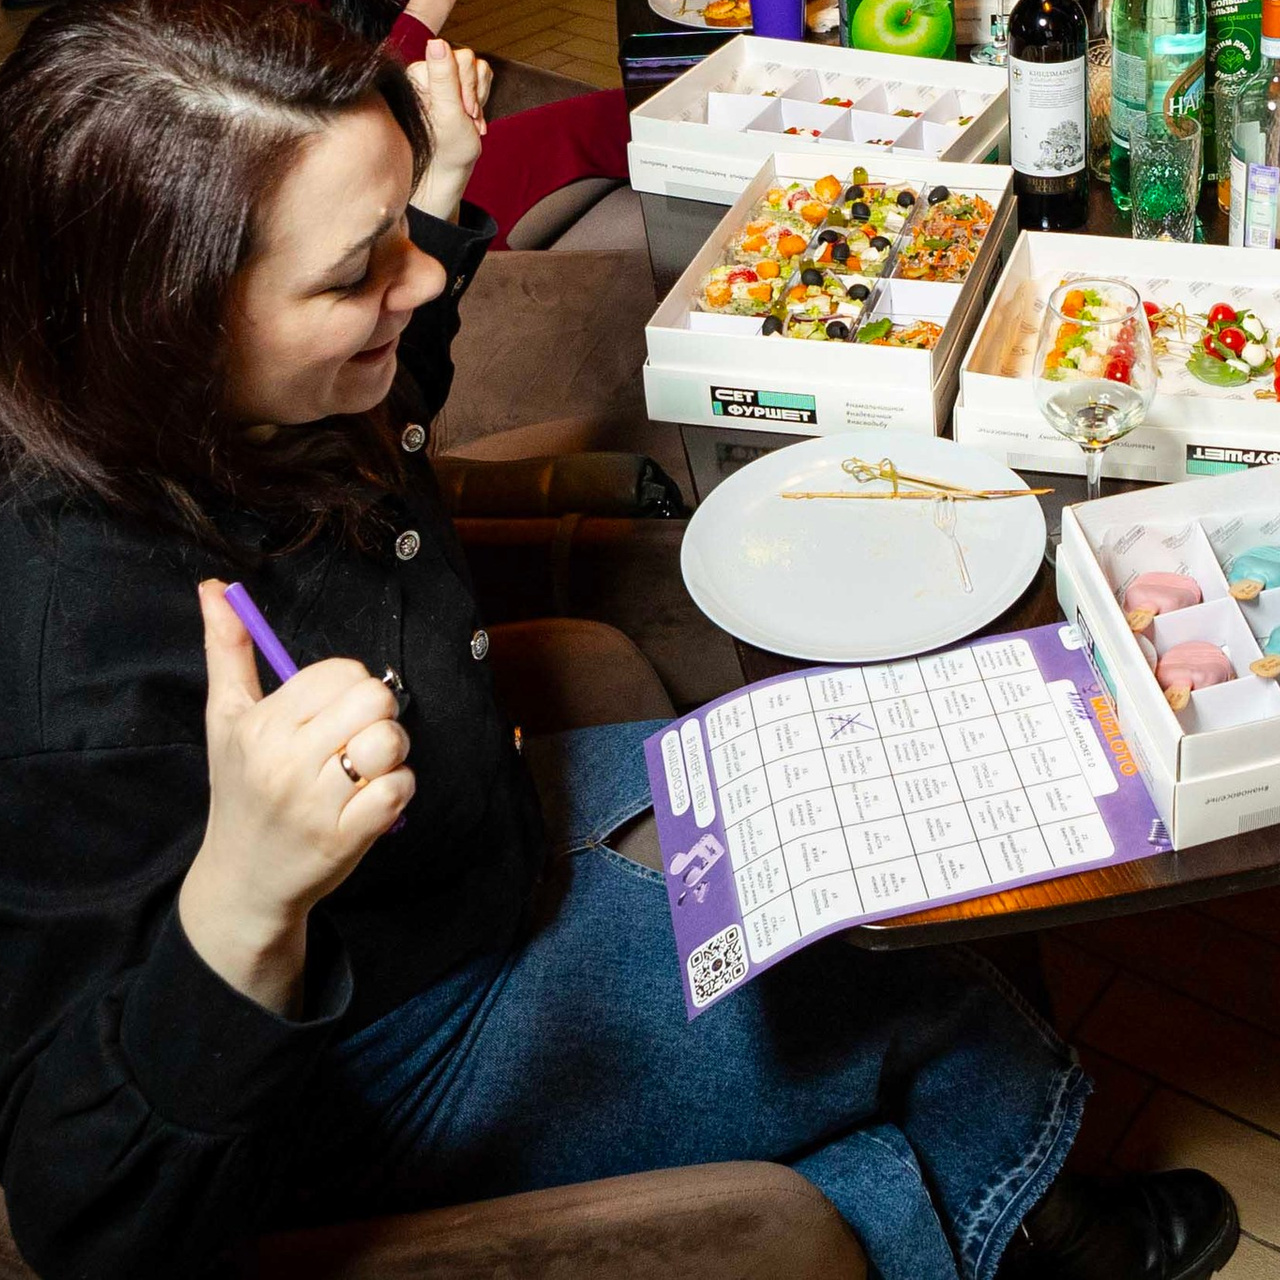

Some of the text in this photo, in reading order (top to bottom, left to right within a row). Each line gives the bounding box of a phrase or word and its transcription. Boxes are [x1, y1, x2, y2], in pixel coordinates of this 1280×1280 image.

[715, 389, 754, 403] СЕТ
[728, 405, 811, 422] ФУРШЕТ
[1073, 727, 1090, 756] КАРАОКЕ
[1089, 697, 1138, 777] MUZLOTO
[685, 743, 703, 778] ПИТЕРЕ
